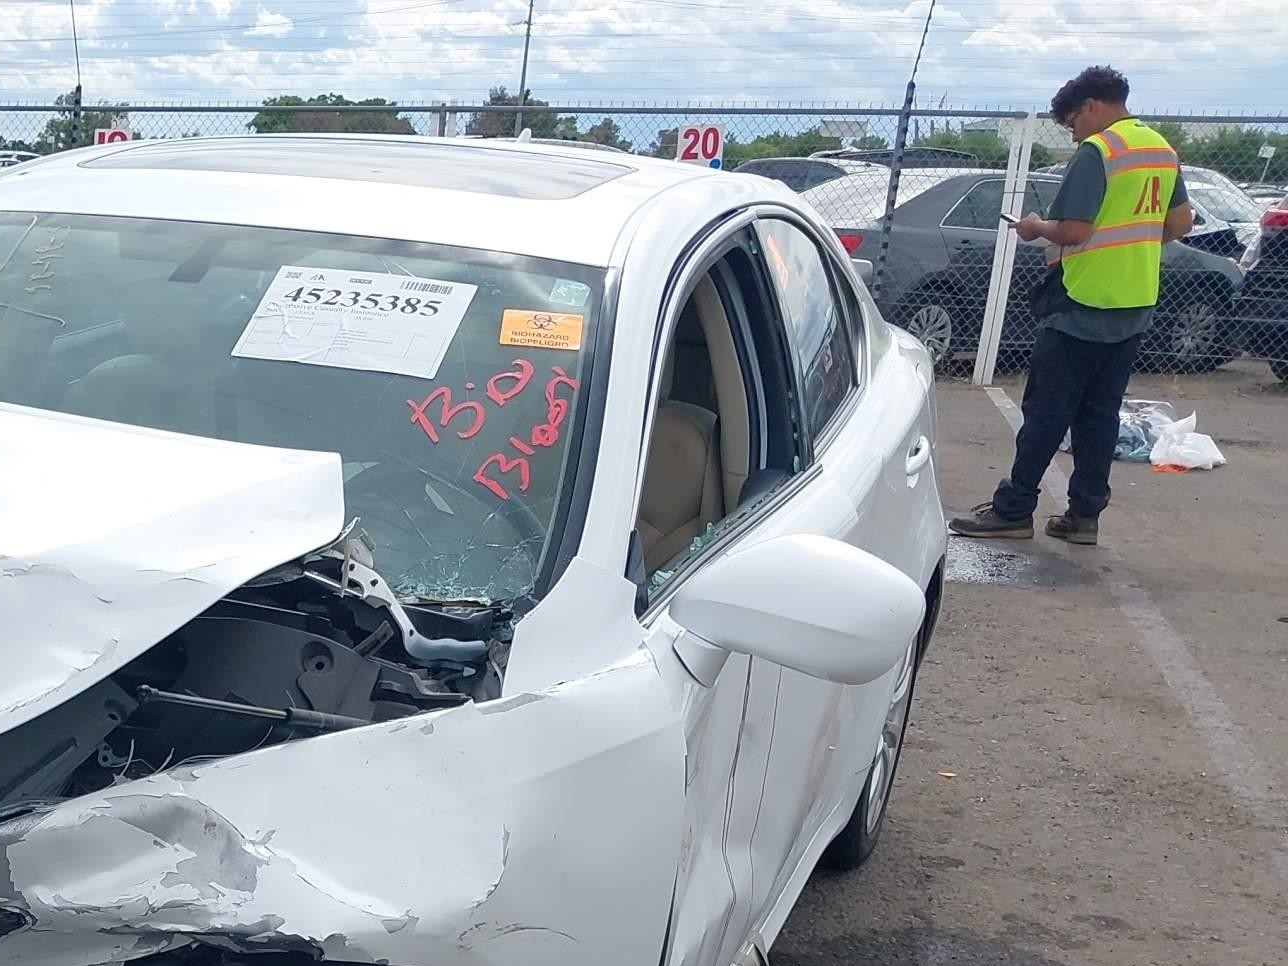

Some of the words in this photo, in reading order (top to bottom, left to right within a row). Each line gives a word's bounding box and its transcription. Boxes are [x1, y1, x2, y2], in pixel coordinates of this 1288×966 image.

[681, 127, 720, 160] 20
[284, 286, 443, 317] 45235385
[509, 337, 569, 347] BIOPELIGRO
[511, 330, 570, 341] BIOHAZARD
